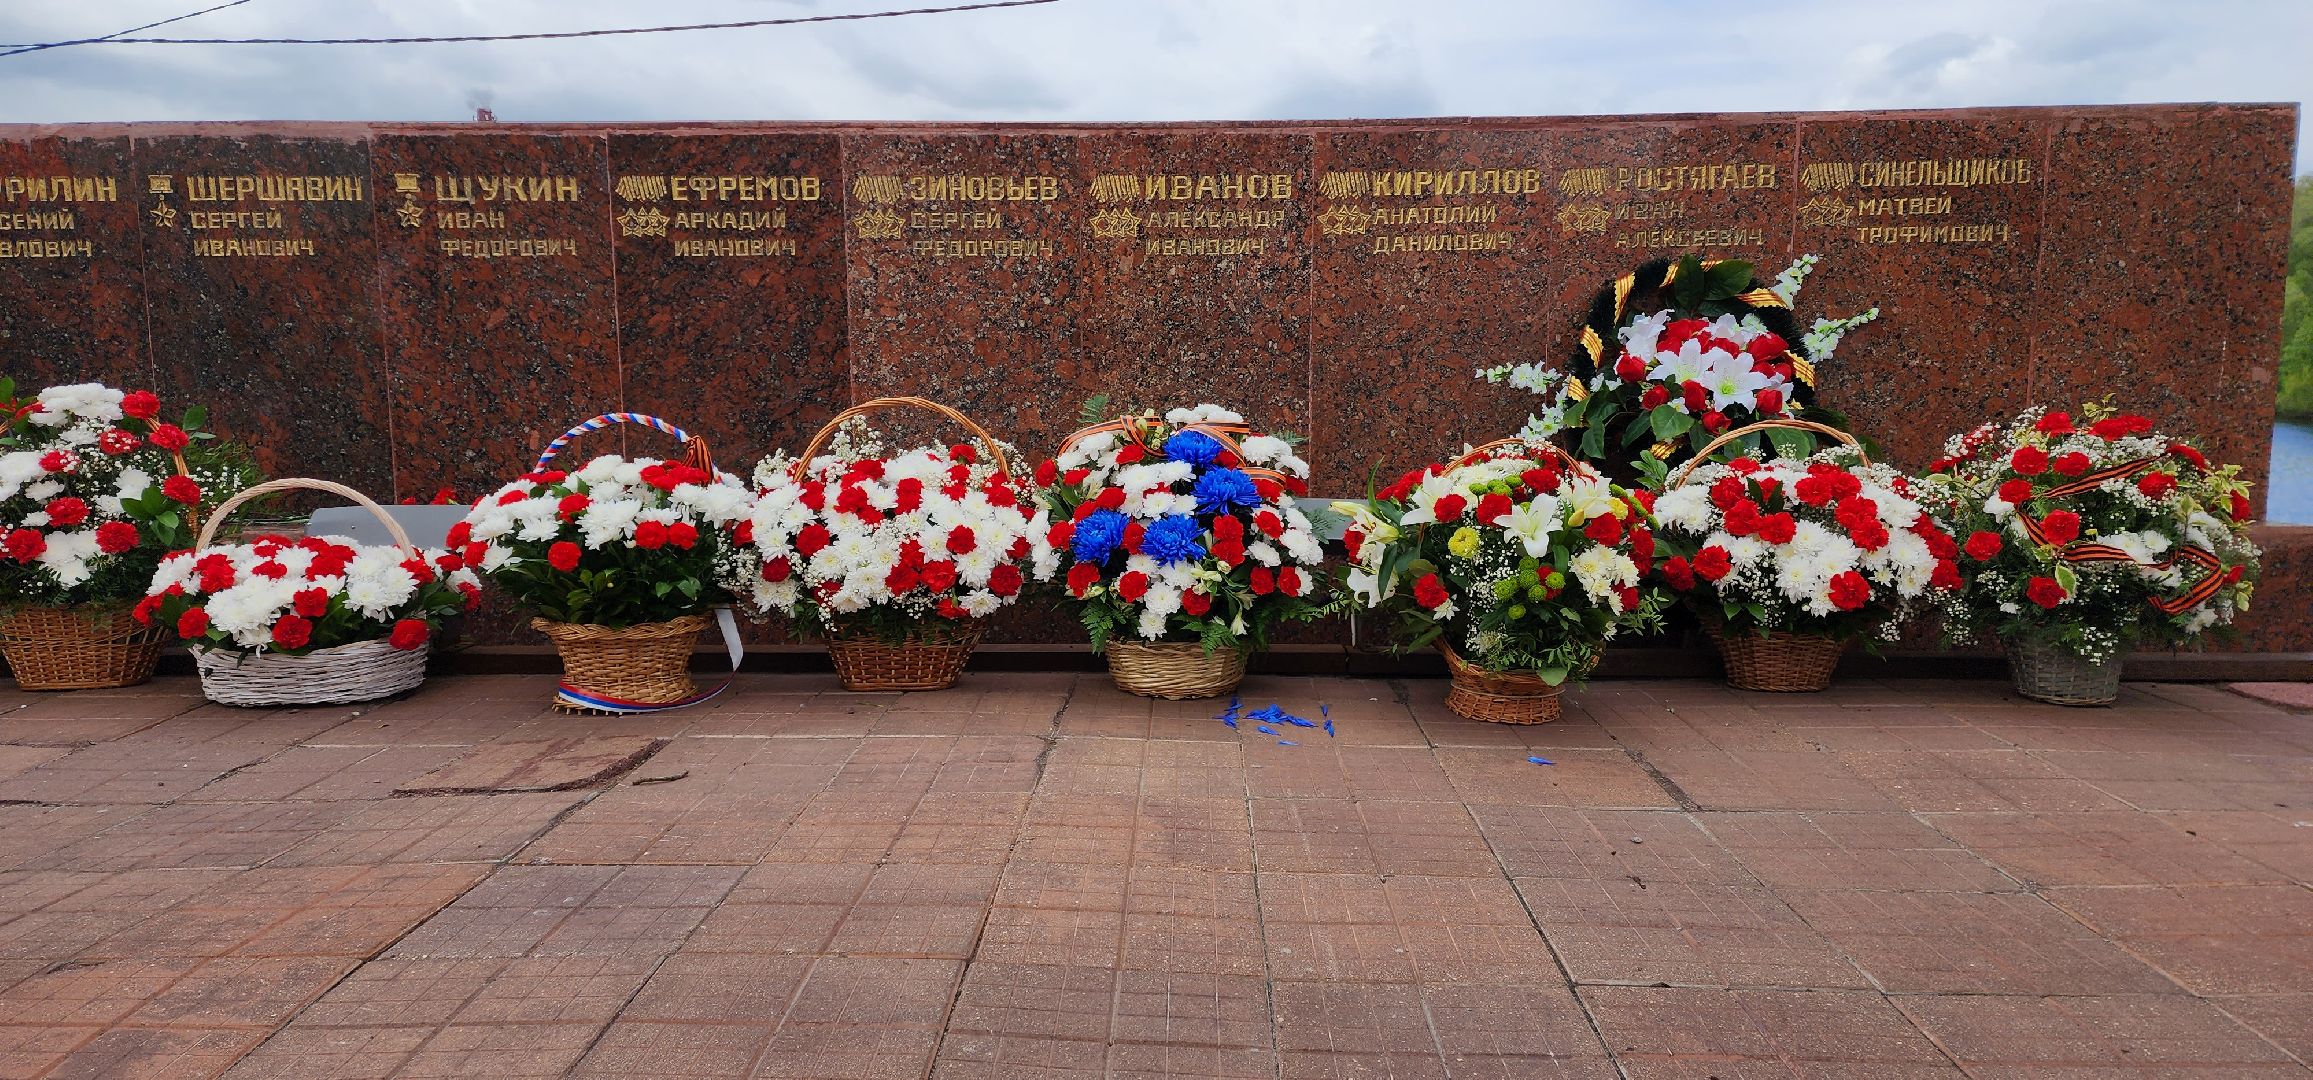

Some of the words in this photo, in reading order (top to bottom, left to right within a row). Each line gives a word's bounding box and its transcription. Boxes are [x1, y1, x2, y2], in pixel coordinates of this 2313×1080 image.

[1372, 167, 1542, 197] КИРИЛЛОВ
[1615, 162, 1778, 194] РОСТЯГАЕВ
[1858, 156, 2033, 190] СИНЕЛЬЩИКОВ
[0, 176, 117, 202] РИЛИН
[186, 175, 363, 202] ШЕРШАВИН
[435, 174, 579, 204] ЩУКИН
[671, 174, 821, 202] ЕФРЕМОВ
[910, 174, 1059, 201] ЗИНОВЬЕВ
[1144, 173, 1293, 201] ИВАНОВ
[1372, 200, 1498, 226] АНАТОЛИЙ
[1614, 200, 1686, 221] ИВАН
[1857, 191, 1953, 217] МАТВЕЙ
[190, 207, 283, 229] СЕРГЕЙ
[438, 210, 505, 230] ИВАН
[674, 206, 788, 231] АРКАДИЙ
[910, 207, 1002, 230] СЕРГЕЙ
[1146, 208, 1287, 229] АЛЕКСАНДР
[1372, 231, 1514, 256] ДАНИЛОВИЧ
[1615, 227, 1766, 251] АЛЕКСЕЕВИЧ
[1856, 222, 2013, 245] ТРОФИМОВИЧ
[193, 238, 315, 258] ИВАНОВИЧ
[440, 238, 578, 258] ФЕДОРОВИЧ
[674, 238, 797, 258] ИВАНОВИЧ
[911, 238, 1054, 258] ФЕДОРОВИЧ
[1144, 237, 1268, 257] ИВАНОВИЧ
